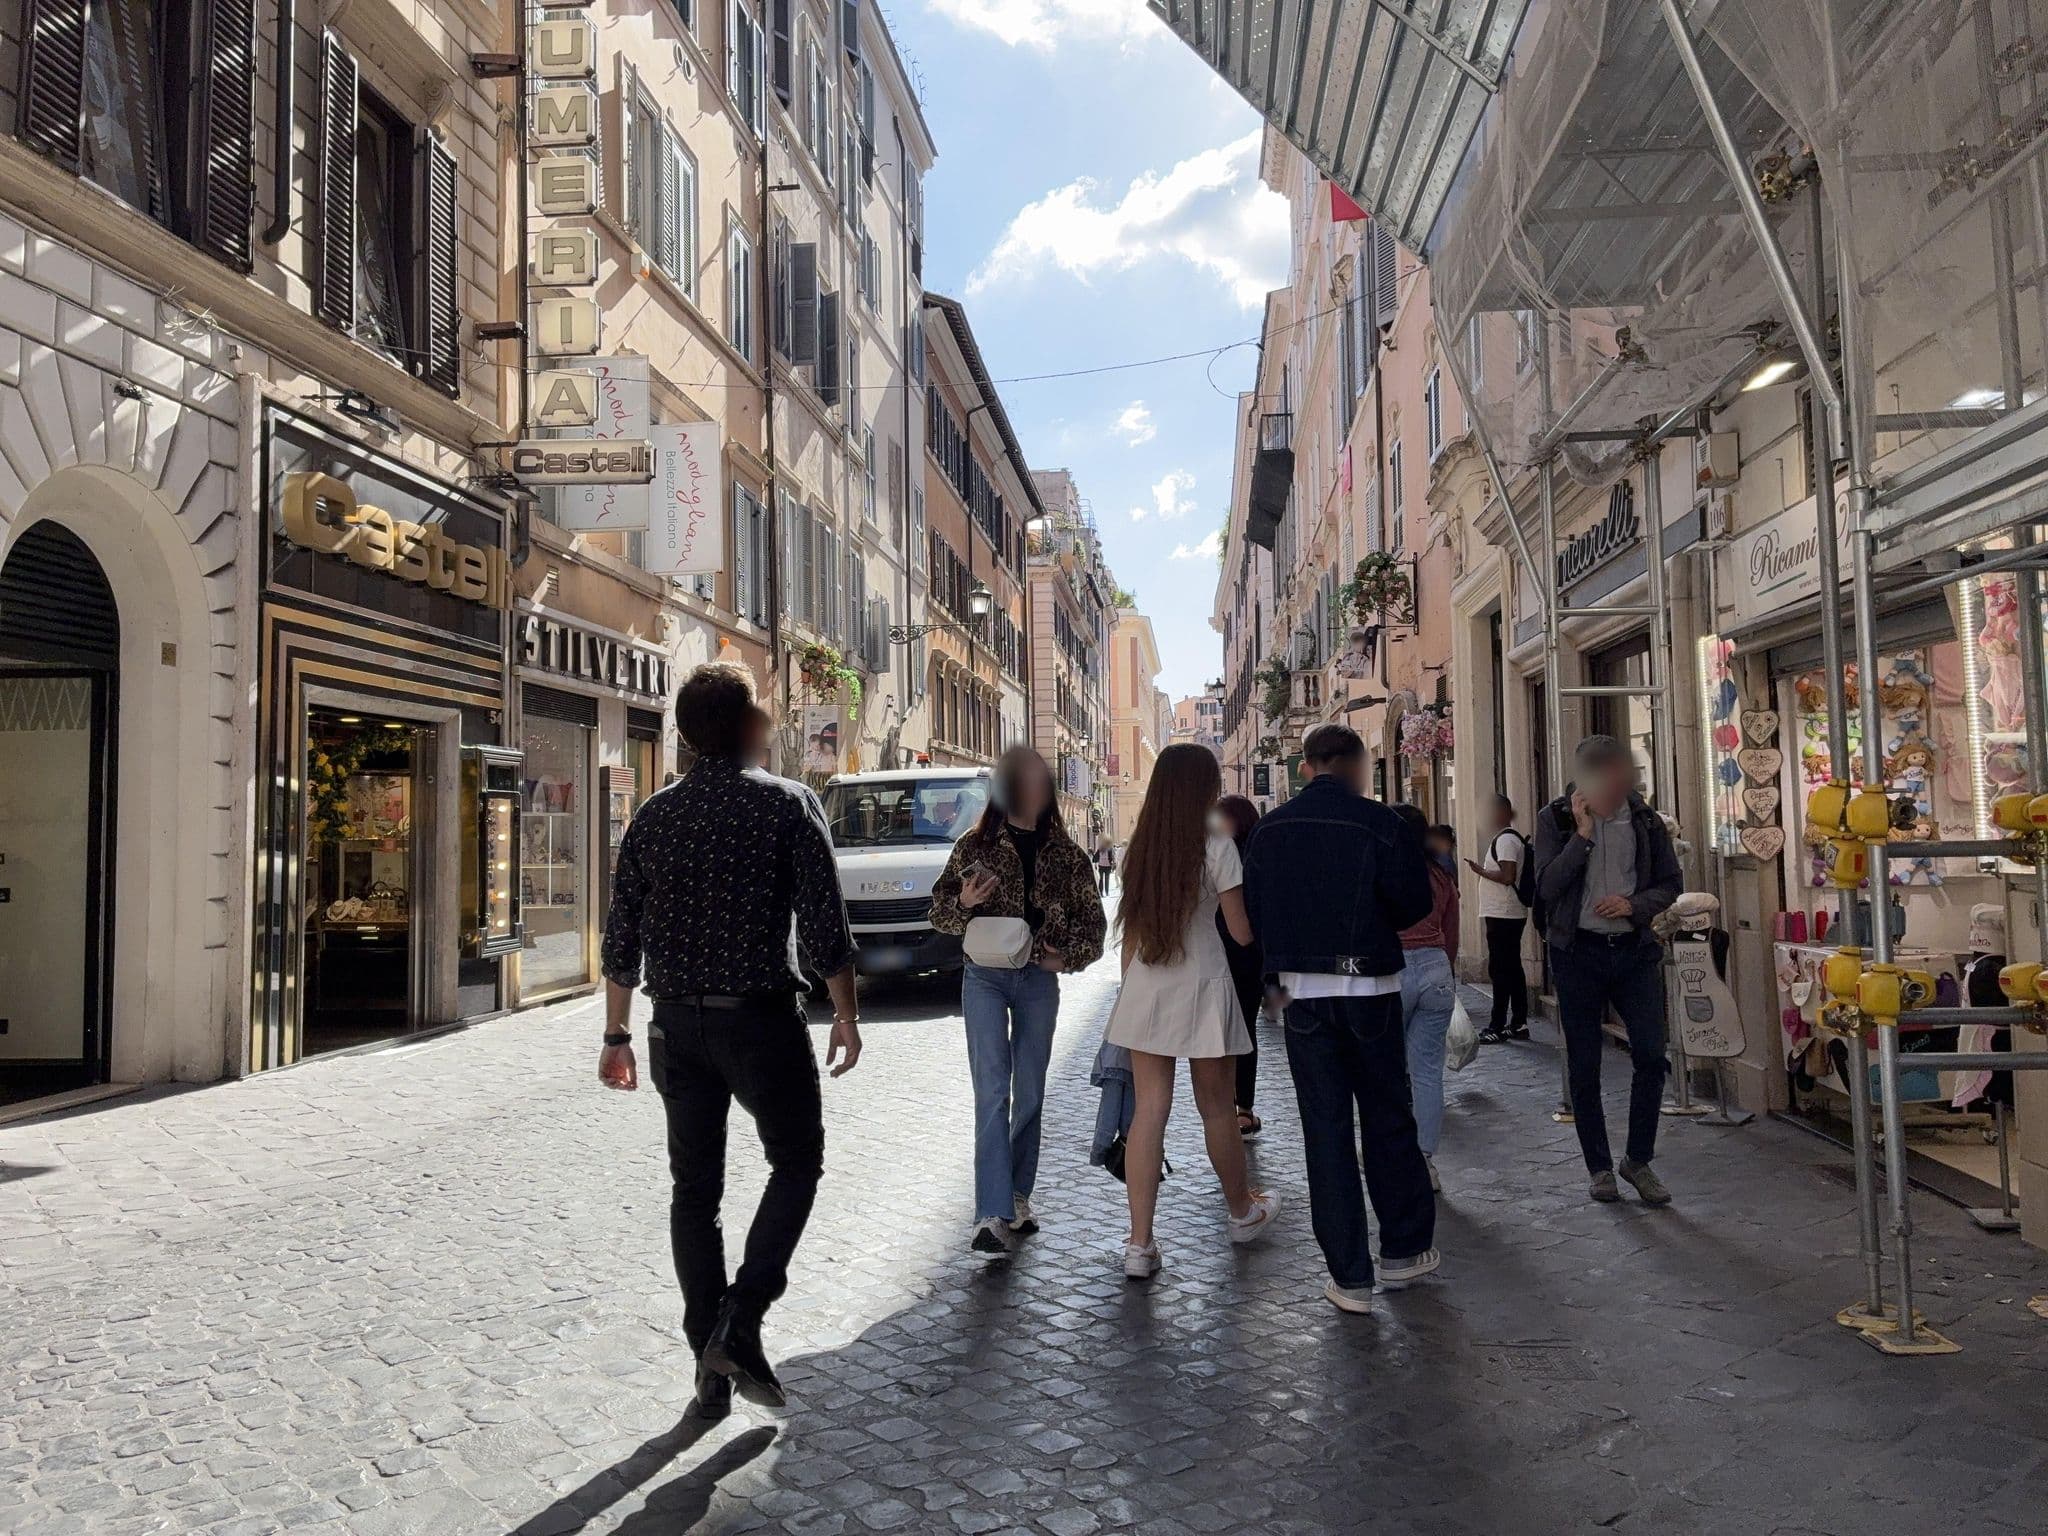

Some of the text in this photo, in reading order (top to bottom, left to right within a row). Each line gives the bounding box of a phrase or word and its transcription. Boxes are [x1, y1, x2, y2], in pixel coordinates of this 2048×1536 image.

[513, 446, 651, 474] Castelli
[665, 450, 678, 549] Bellezza Italiana
[676, 433, 710, 568] modigliani
[1710, 508, 1725, 531] 106
[1751, 527, 1819, 587] Ricami
[521, 615, 674, 697] STILVETRO
